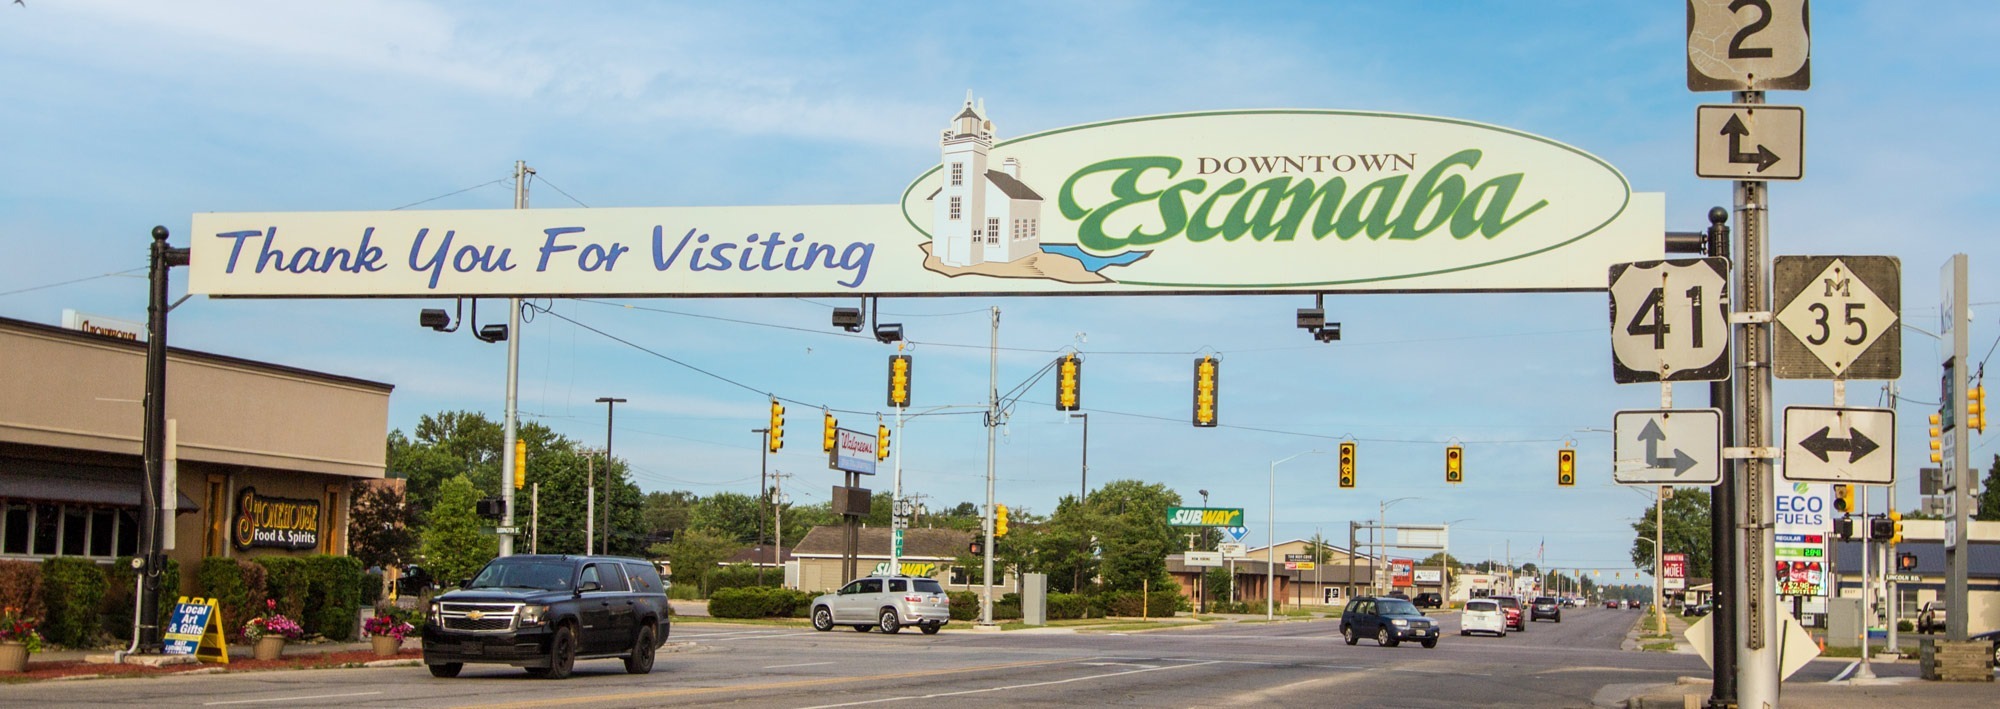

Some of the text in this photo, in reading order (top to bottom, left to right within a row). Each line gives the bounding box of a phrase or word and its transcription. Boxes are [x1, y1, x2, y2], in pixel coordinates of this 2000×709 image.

[1728, 0, 1773, 59] 2
[1197, 153, 1417, 174] DOWNTOWN
[1057, 148, 1549, 251] Escanaba
[216, 225, 875, 289] Thank You For Visiting
[1824, 279, 1850, 297] M
[1627, 285, 1704, 350] 41
[1806, 303, 1867, 346] 35
[841, 432, 873, 456] Walgreens
[1776, 495, 1823, 512] ECO
[237, 492, 318, 545] STONEHOUSE
[1170, 509, 1239, 524] SUBWAY
[1776, 513, 1822, 525] FUELS
[254, 529, 316, 545] Food & Spirits
[1775, 534, 1802, 542] REGULAR
[1663, 563, 1684, 578] MOTEL
[180, 603, 208, 615] Local
[181, 613, 199, 625] Art
[169, 622, 204, 635] & Gifts
